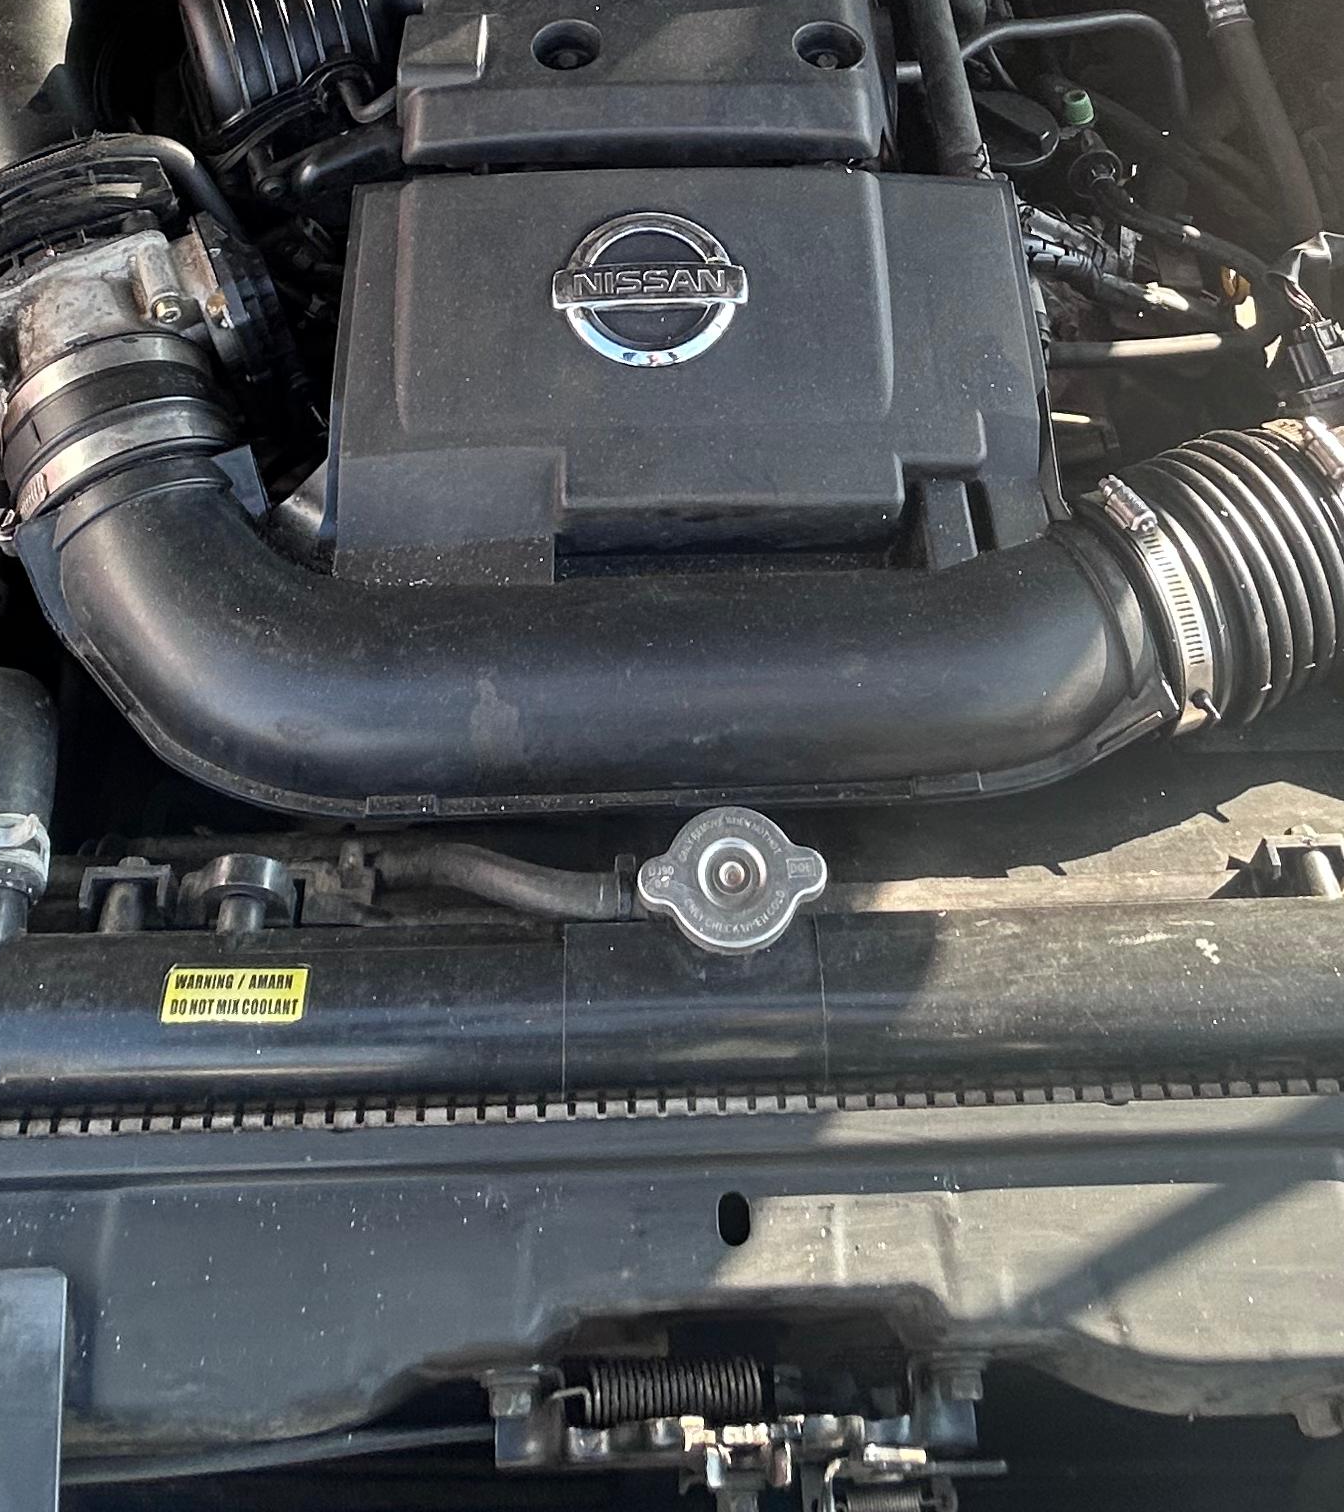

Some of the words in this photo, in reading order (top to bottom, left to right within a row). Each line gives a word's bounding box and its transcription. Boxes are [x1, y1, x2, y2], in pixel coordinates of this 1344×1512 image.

[573, 268, 726, 297] NISSAN
[175, 974, 234, 989] WARNING
[248, 974, 294, 989] AMARN
[169, 998, 187, 1015] DO
[189, 998, 215, 1015] NOT
[216, 998, 240, 1015] MIX
[241, 998, 299, 1015] COOLANT
